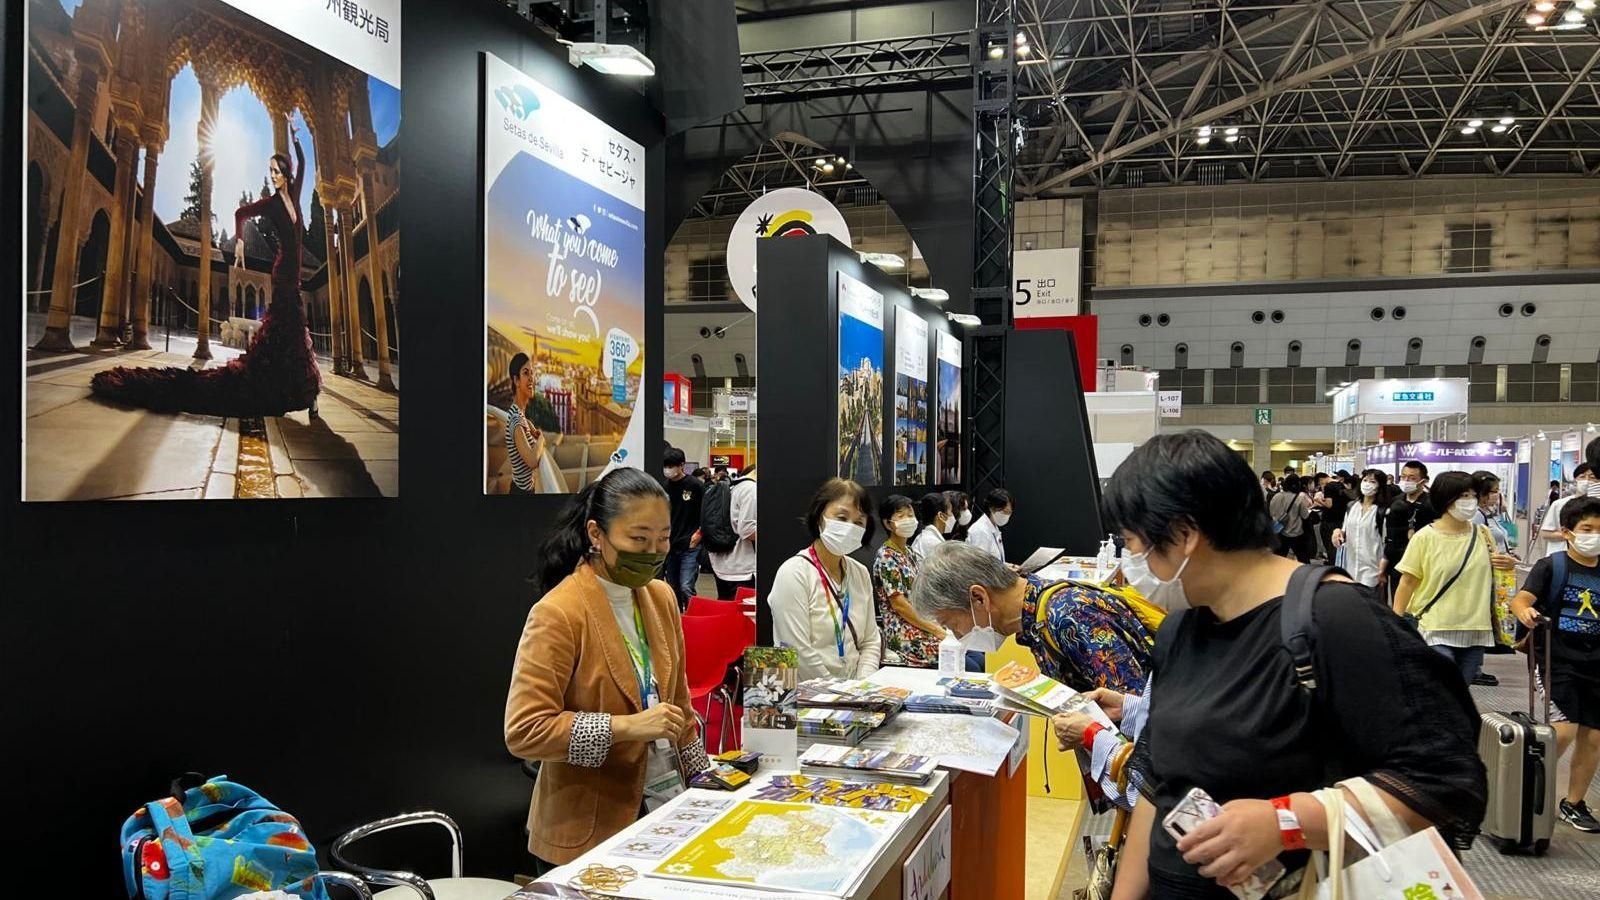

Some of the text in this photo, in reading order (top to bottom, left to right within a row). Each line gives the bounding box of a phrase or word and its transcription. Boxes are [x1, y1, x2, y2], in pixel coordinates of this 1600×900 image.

[504, 117, 565, 160] Setas de Sevilla
[527, 209, 562, 244] What
[563, 232, 587, 259] you
[587, 239, 619, 268] come
[547, 242, 601, 306] to see
[1037, 278, 1056, 289] 出口
[1015, 279, 1032, 306] 5
[1037, 289, 1051, 298] Exit
